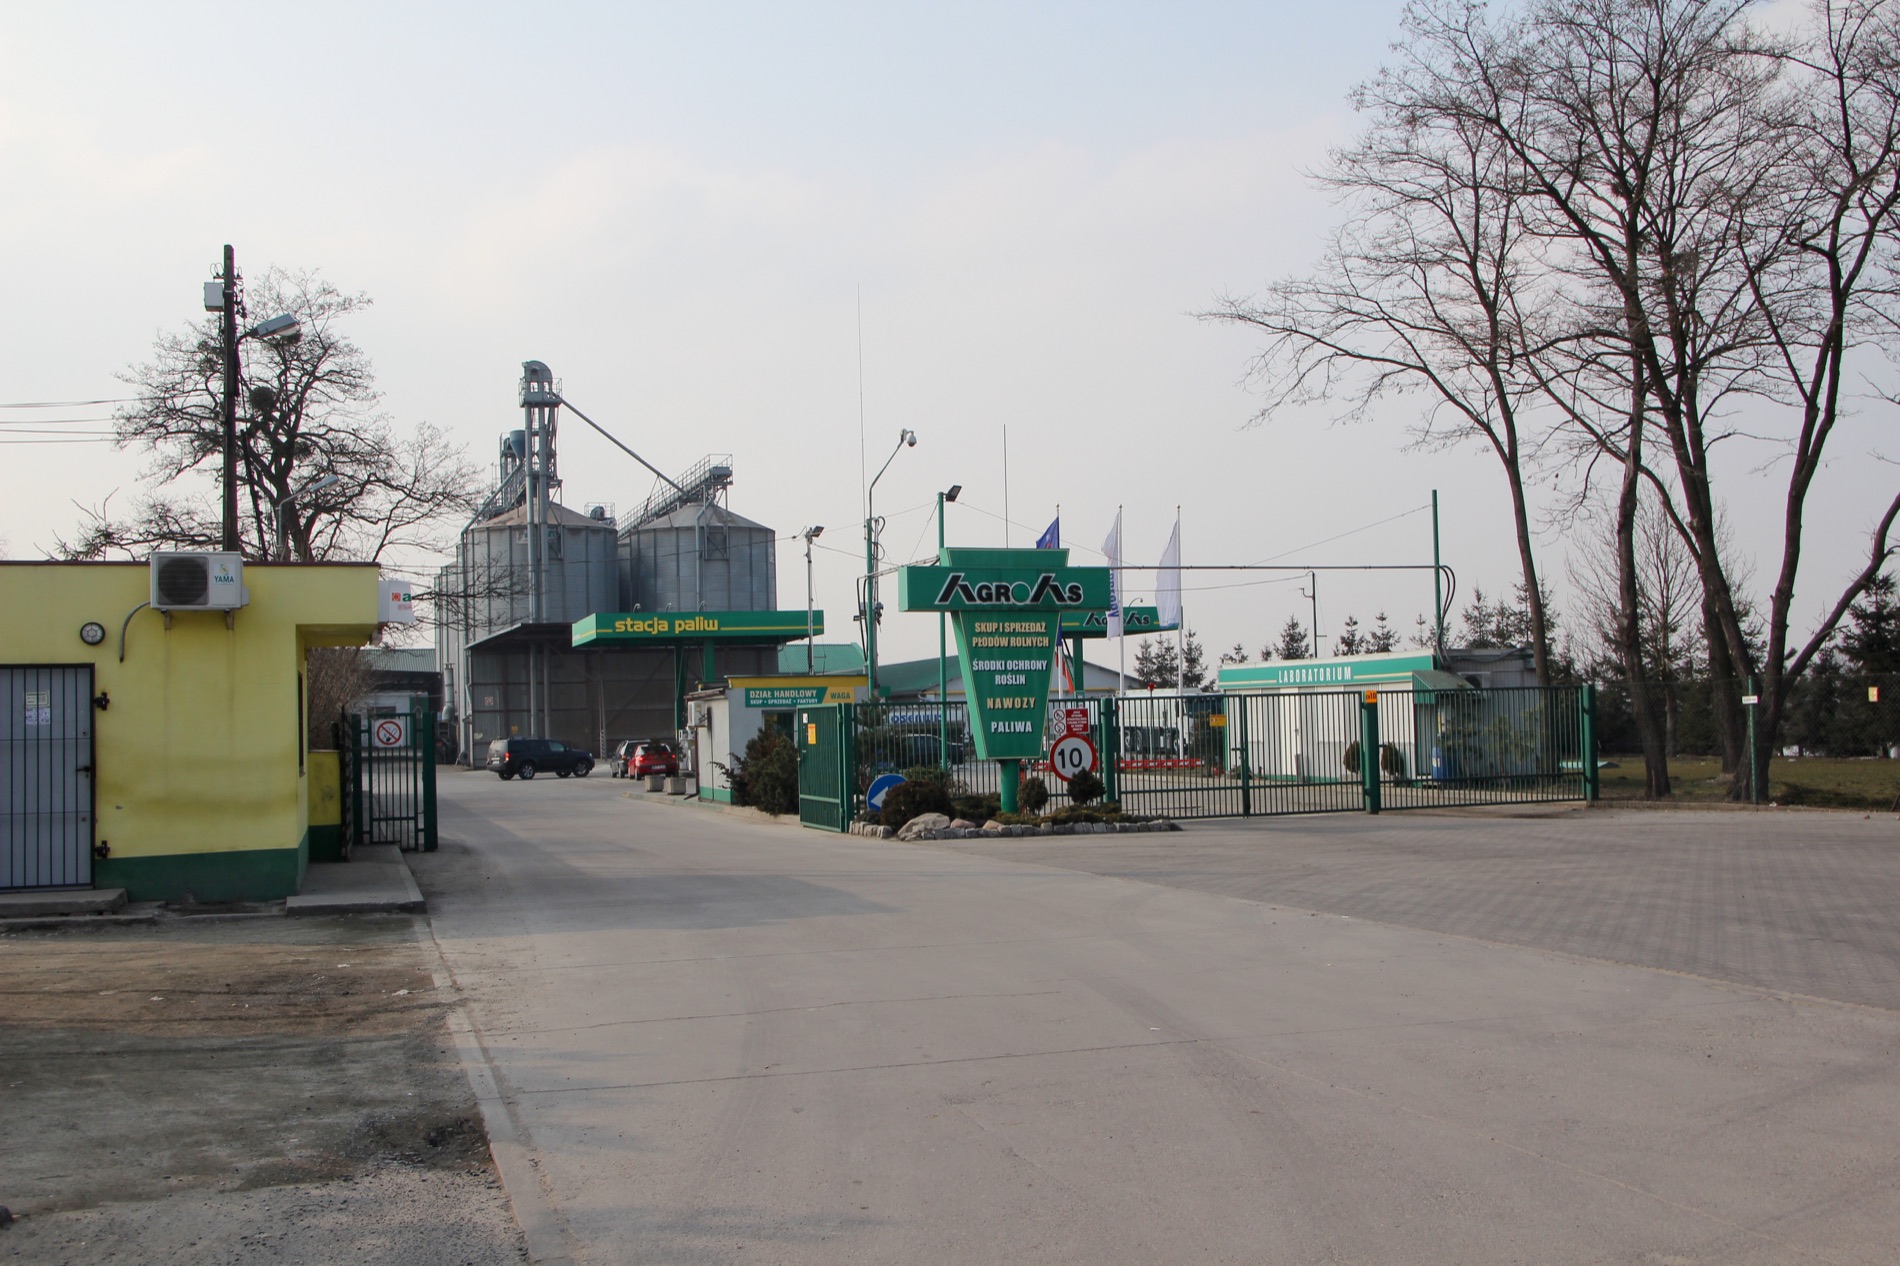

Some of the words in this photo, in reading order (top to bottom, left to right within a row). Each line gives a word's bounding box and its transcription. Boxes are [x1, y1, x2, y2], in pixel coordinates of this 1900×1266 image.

[615, 617, 669, 635] stacja
[675, 616, 719, 634] paliw
[975, 622, 998, 633] SKUP
[1004, 621, 1046, 633] SPRZEDAŻ
[972, 635, 1009, 647] PŁODÓW
[1010, 636, 1049, 647] ROLNYCH
[972, 658, 1005, 671] ŚRODKI
[1006, 659, 1048, 671] OCHRONY
[994, 672, 1026, 685] ROŚLIN
[1278, 666, 1352, 683] LABORATORIUM
[749, 690, 773, 699] DZIAŁ
[774, 689, 818, 698] HANDLOWY
[830, 692, 851, 700] WAGA
[987, 697, 1036, 709] NAWOZY
[991, 721, 1033, 733] PALIWA
[1058, 747, 1083, 769] 10
